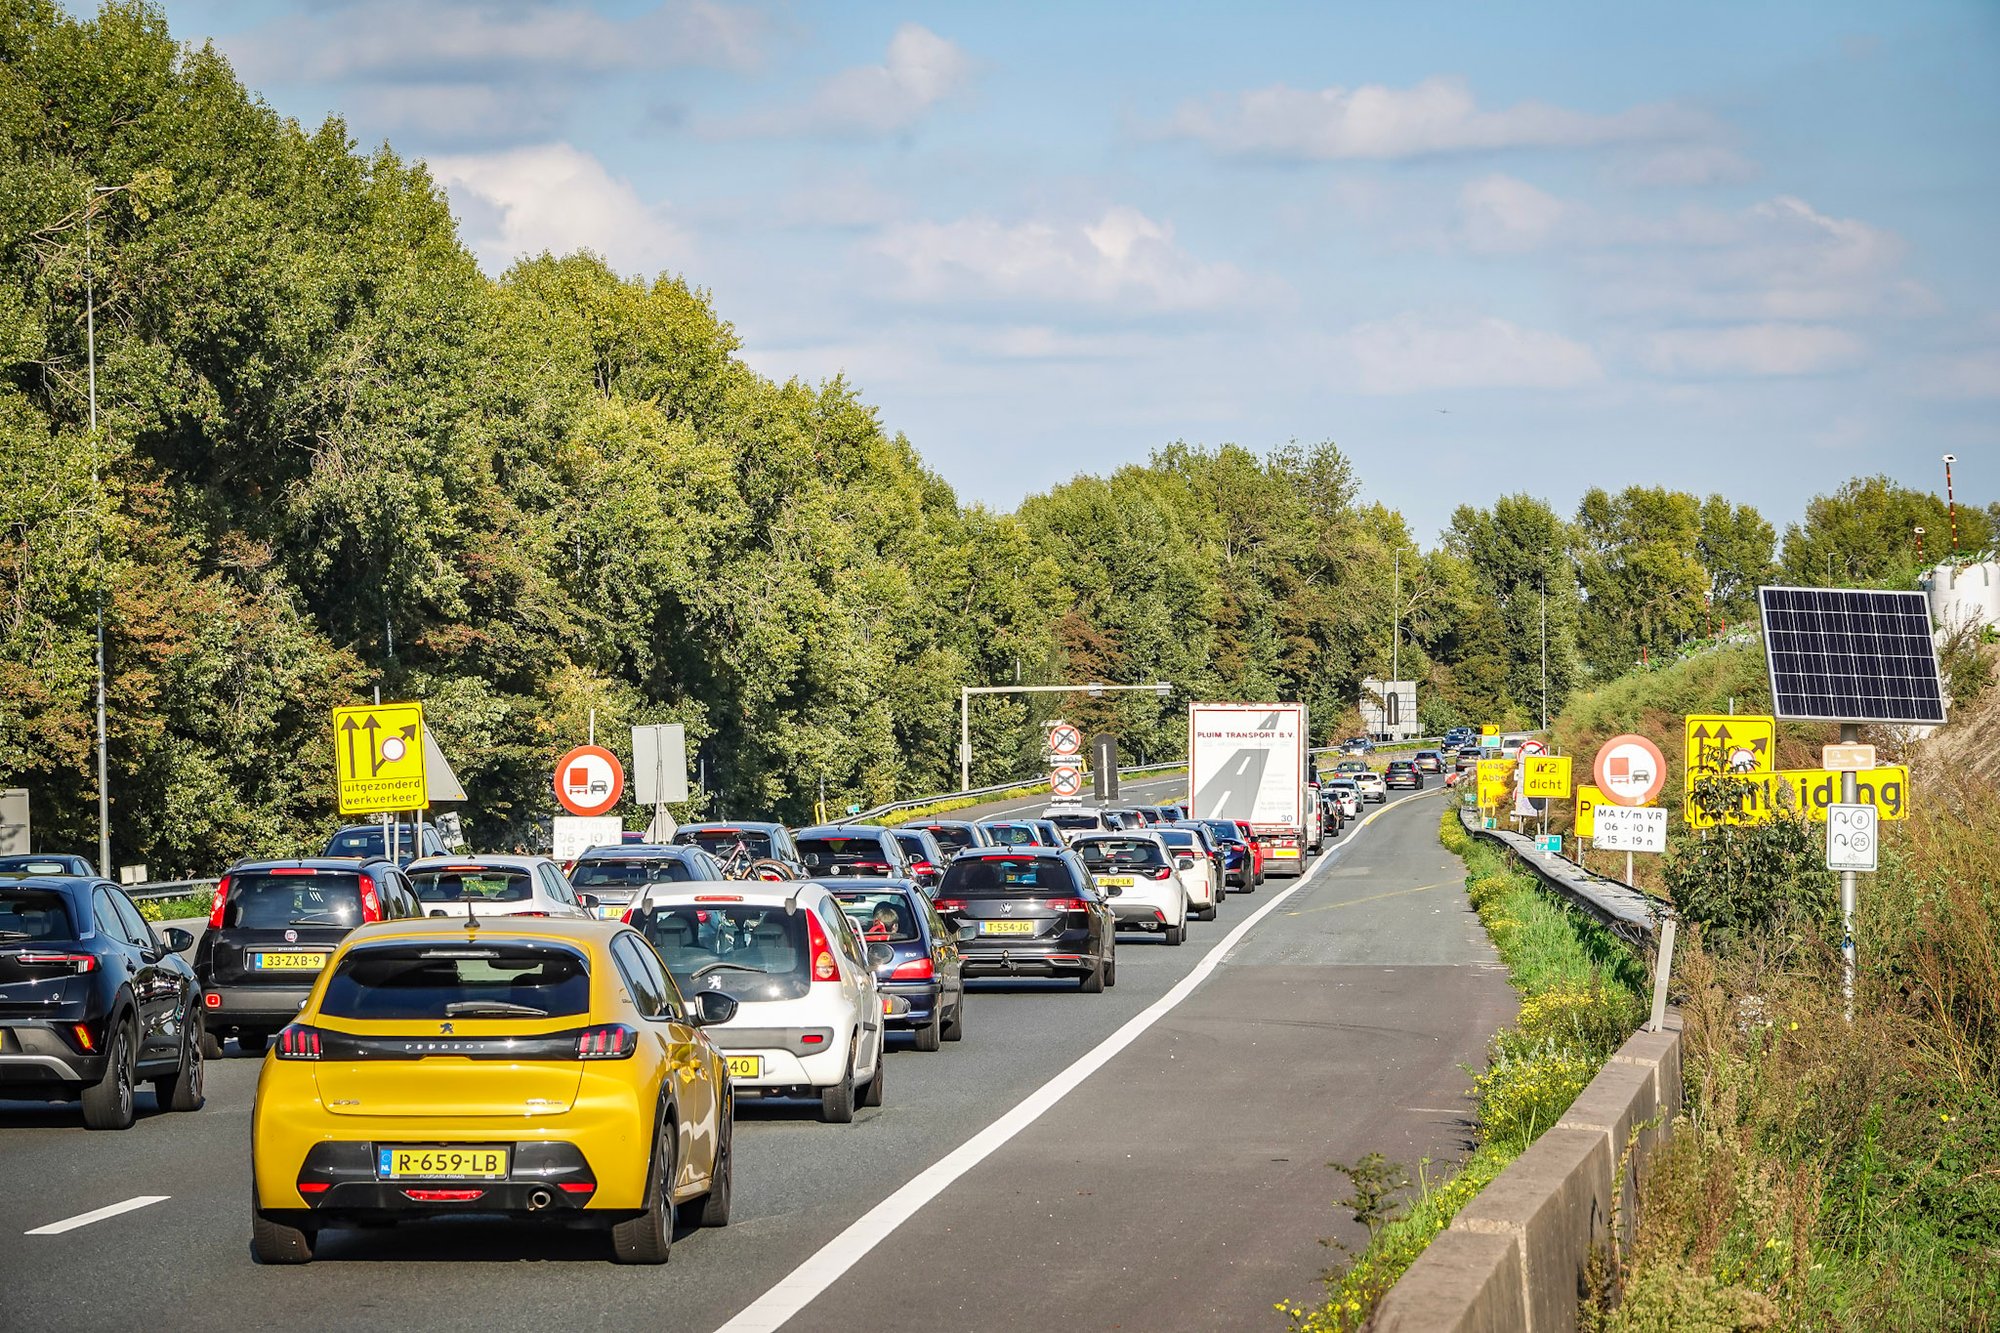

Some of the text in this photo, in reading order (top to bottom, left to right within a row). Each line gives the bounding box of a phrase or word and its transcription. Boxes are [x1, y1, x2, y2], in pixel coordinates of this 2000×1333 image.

[1549, 763, 1557, 773] 2
[344, 779, 421, 793] uitgezonderd
[1529, 779, 1562, 790] dicht
[345, 794, 418, 806] werkverkeer
[1696, 776, 1900, 815] lidng
[1598, 809, 1616, 818] MA
[1620, 810, 1642, 819] t/m
[1647, 811, 1663, 820] VR
[1857, 816, 1863, 824] 8
[1604, 822, 1618, 831] 06
[1633, 824, 1644, 832] 10
[1648, 825, 1654, 833] h
[1607, 835, 1618, 844] 15
[1632, 836, 1643, 845] 19
[1854, 838, 1866, 847] 25
[988, 923, 1030, 932] T-554-JG
[267, 955, 321, 967] 33-ZXB-9
[381, 1164, 391, 1172] NL
[399, 1154, 498, 1172] R-659-LB
